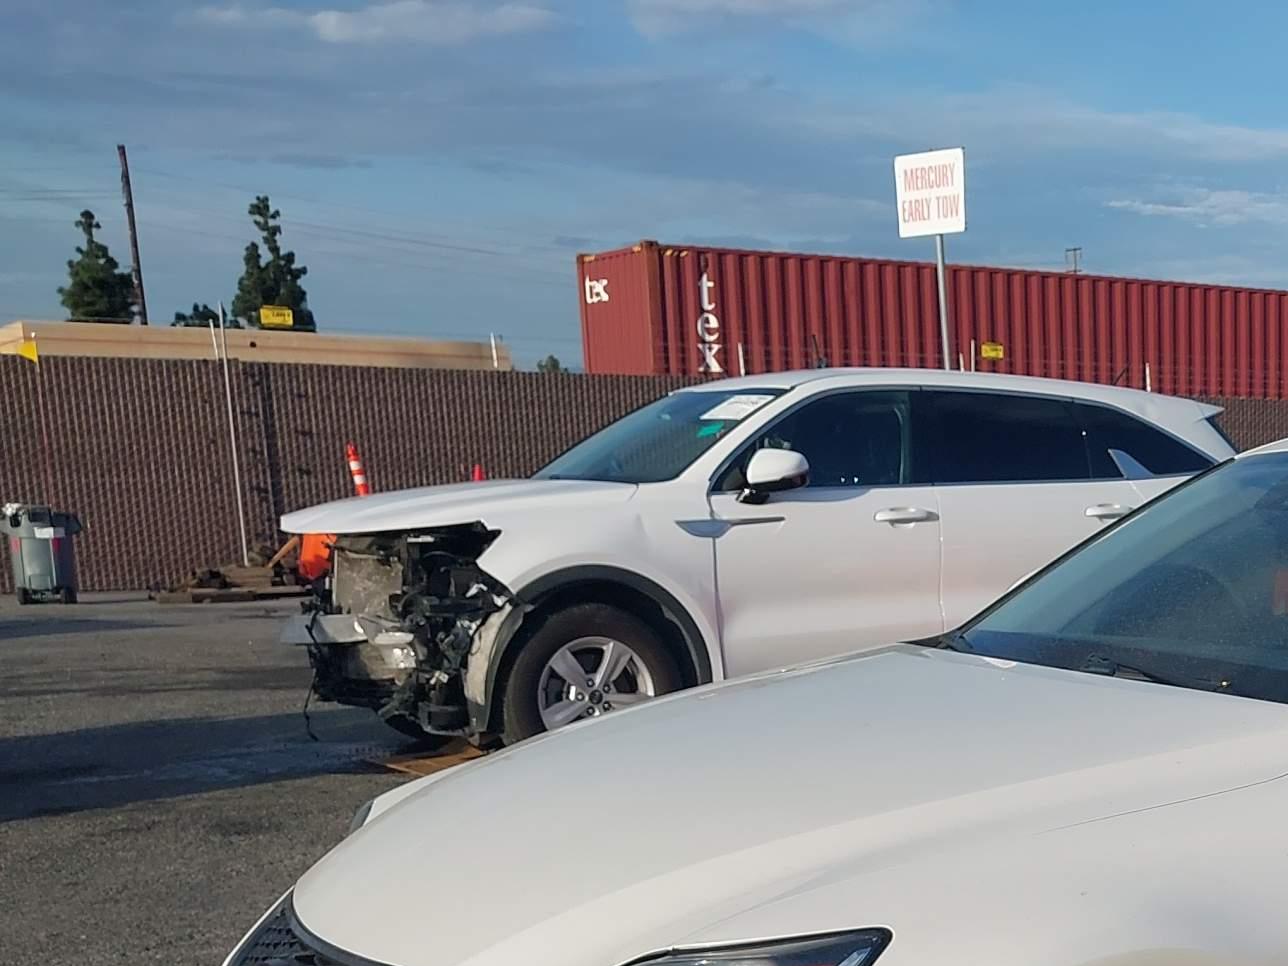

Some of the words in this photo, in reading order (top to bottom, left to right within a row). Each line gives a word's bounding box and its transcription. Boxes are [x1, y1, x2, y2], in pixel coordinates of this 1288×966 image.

[903, 162, 956, 193] MERCURY
[902, 196, 933, 223] EARLY
[936, 194, 960, 219] TOW
[697, 272, 724, 373] tex
